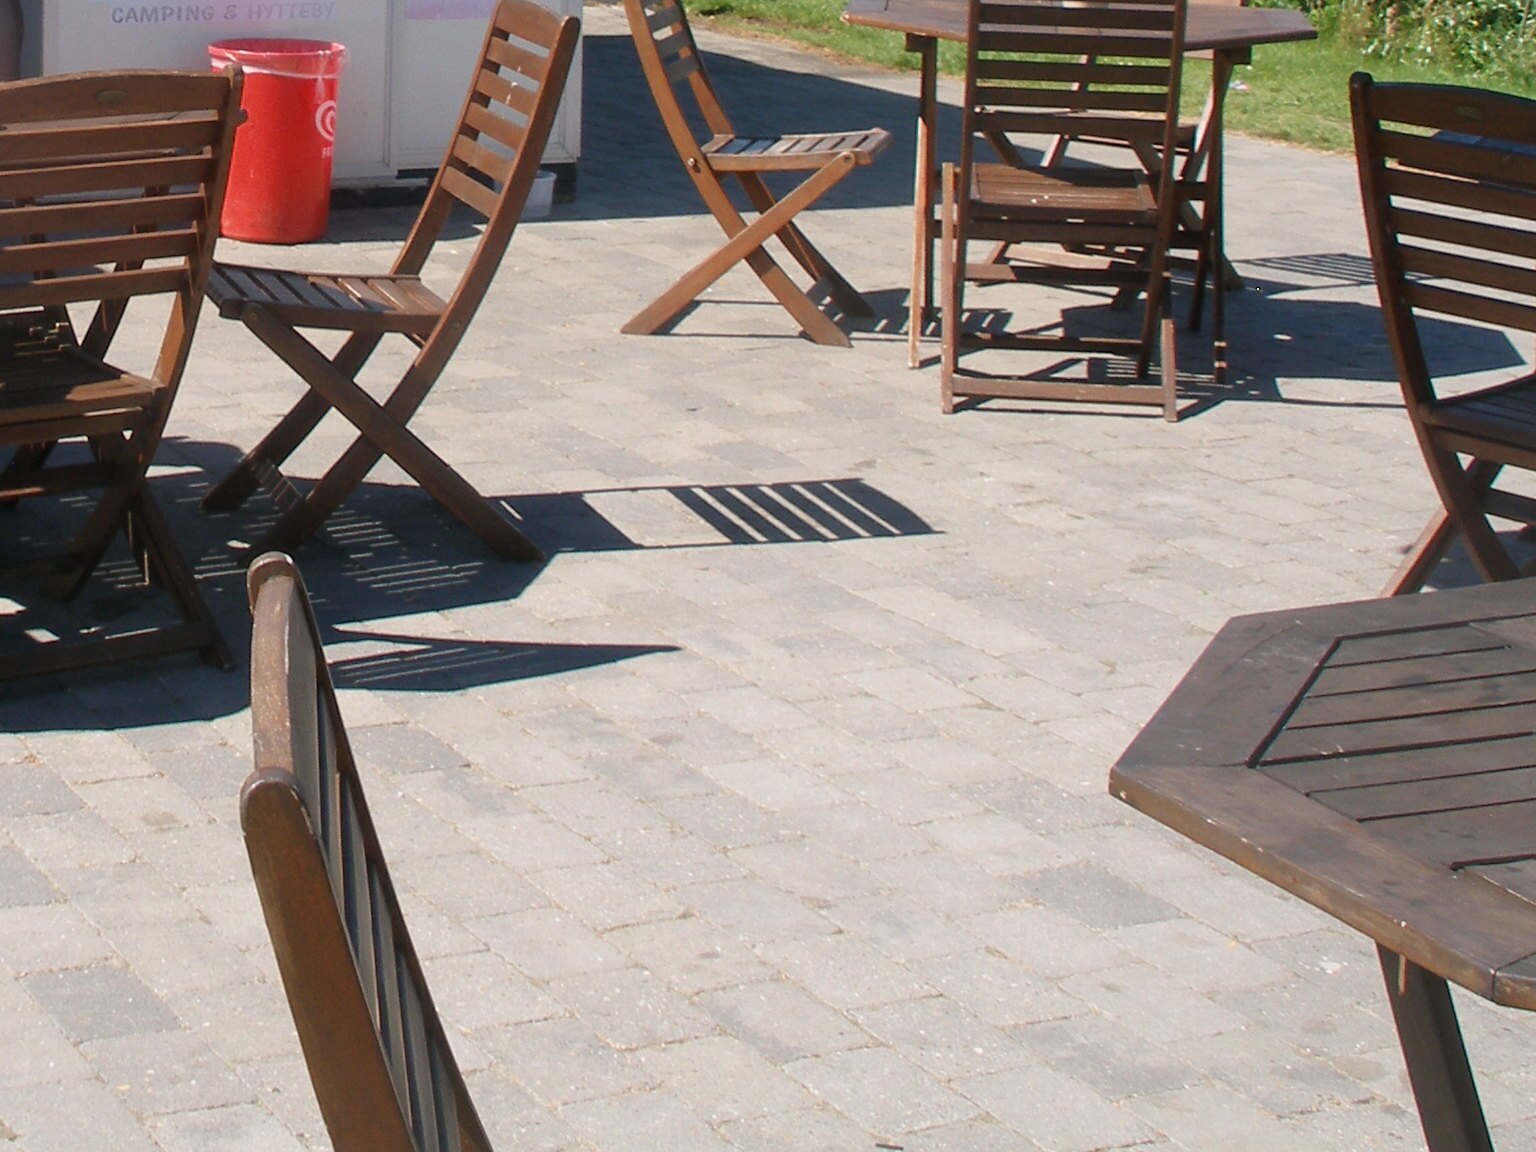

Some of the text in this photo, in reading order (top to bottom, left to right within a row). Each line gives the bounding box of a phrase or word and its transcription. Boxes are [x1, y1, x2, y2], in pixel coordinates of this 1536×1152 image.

[111, 1, 336, 24] CAMPING & HYTTEBY
